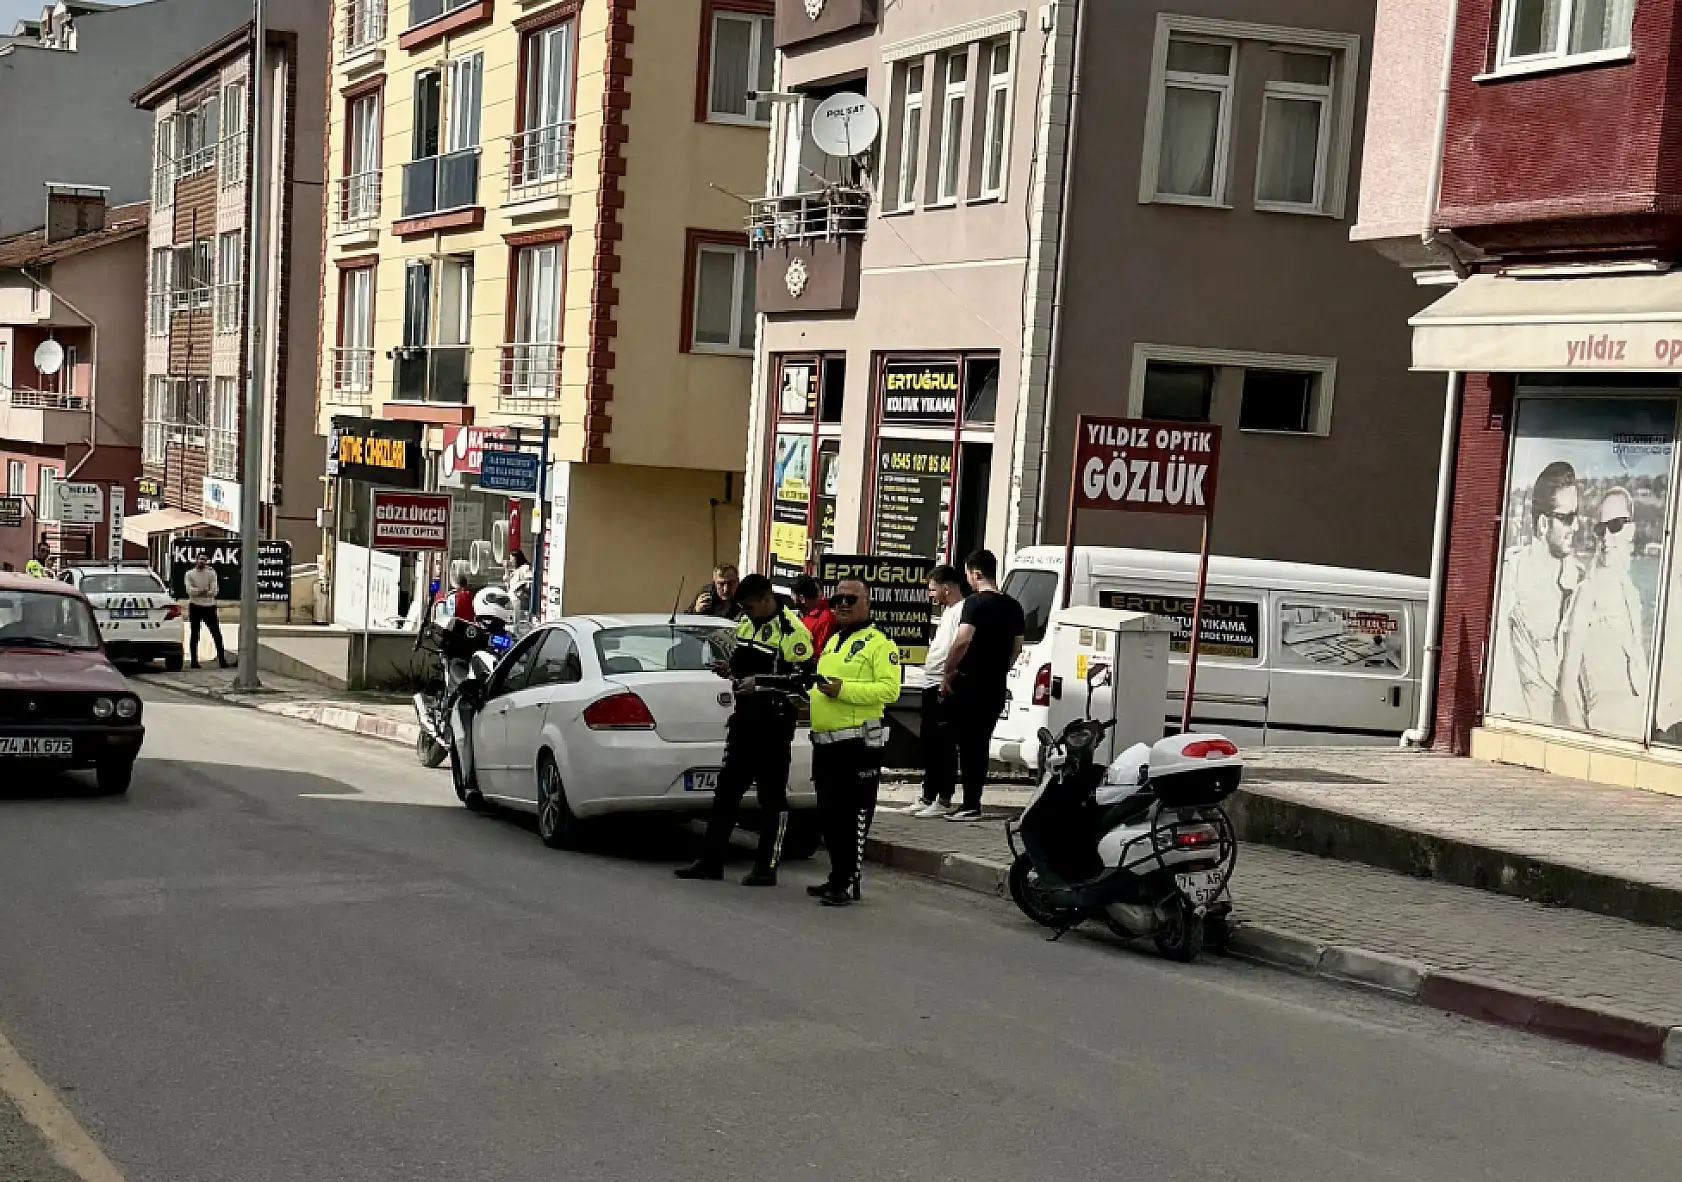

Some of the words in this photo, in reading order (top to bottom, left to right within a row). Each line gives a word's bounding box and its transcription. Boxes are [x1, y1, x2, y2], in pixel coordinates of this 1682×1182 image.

[826, 104, 865, 117] POLSAT
[1566, 333, 1628, 366] yıldız
[886, 368, 958, 390] ERTUĞRUL
[1087, 424, 1150, 448] YILDIZ
[1083, 451, 1209, 506] GÖZLÜK
[376, 503, 447, 524] GÖZLÜKÇÜ
[381, 525, 410, 535] HAYAT
[1201, 617, 1247, 633] YIKAMA
[44, 740, 72, 752] 675
